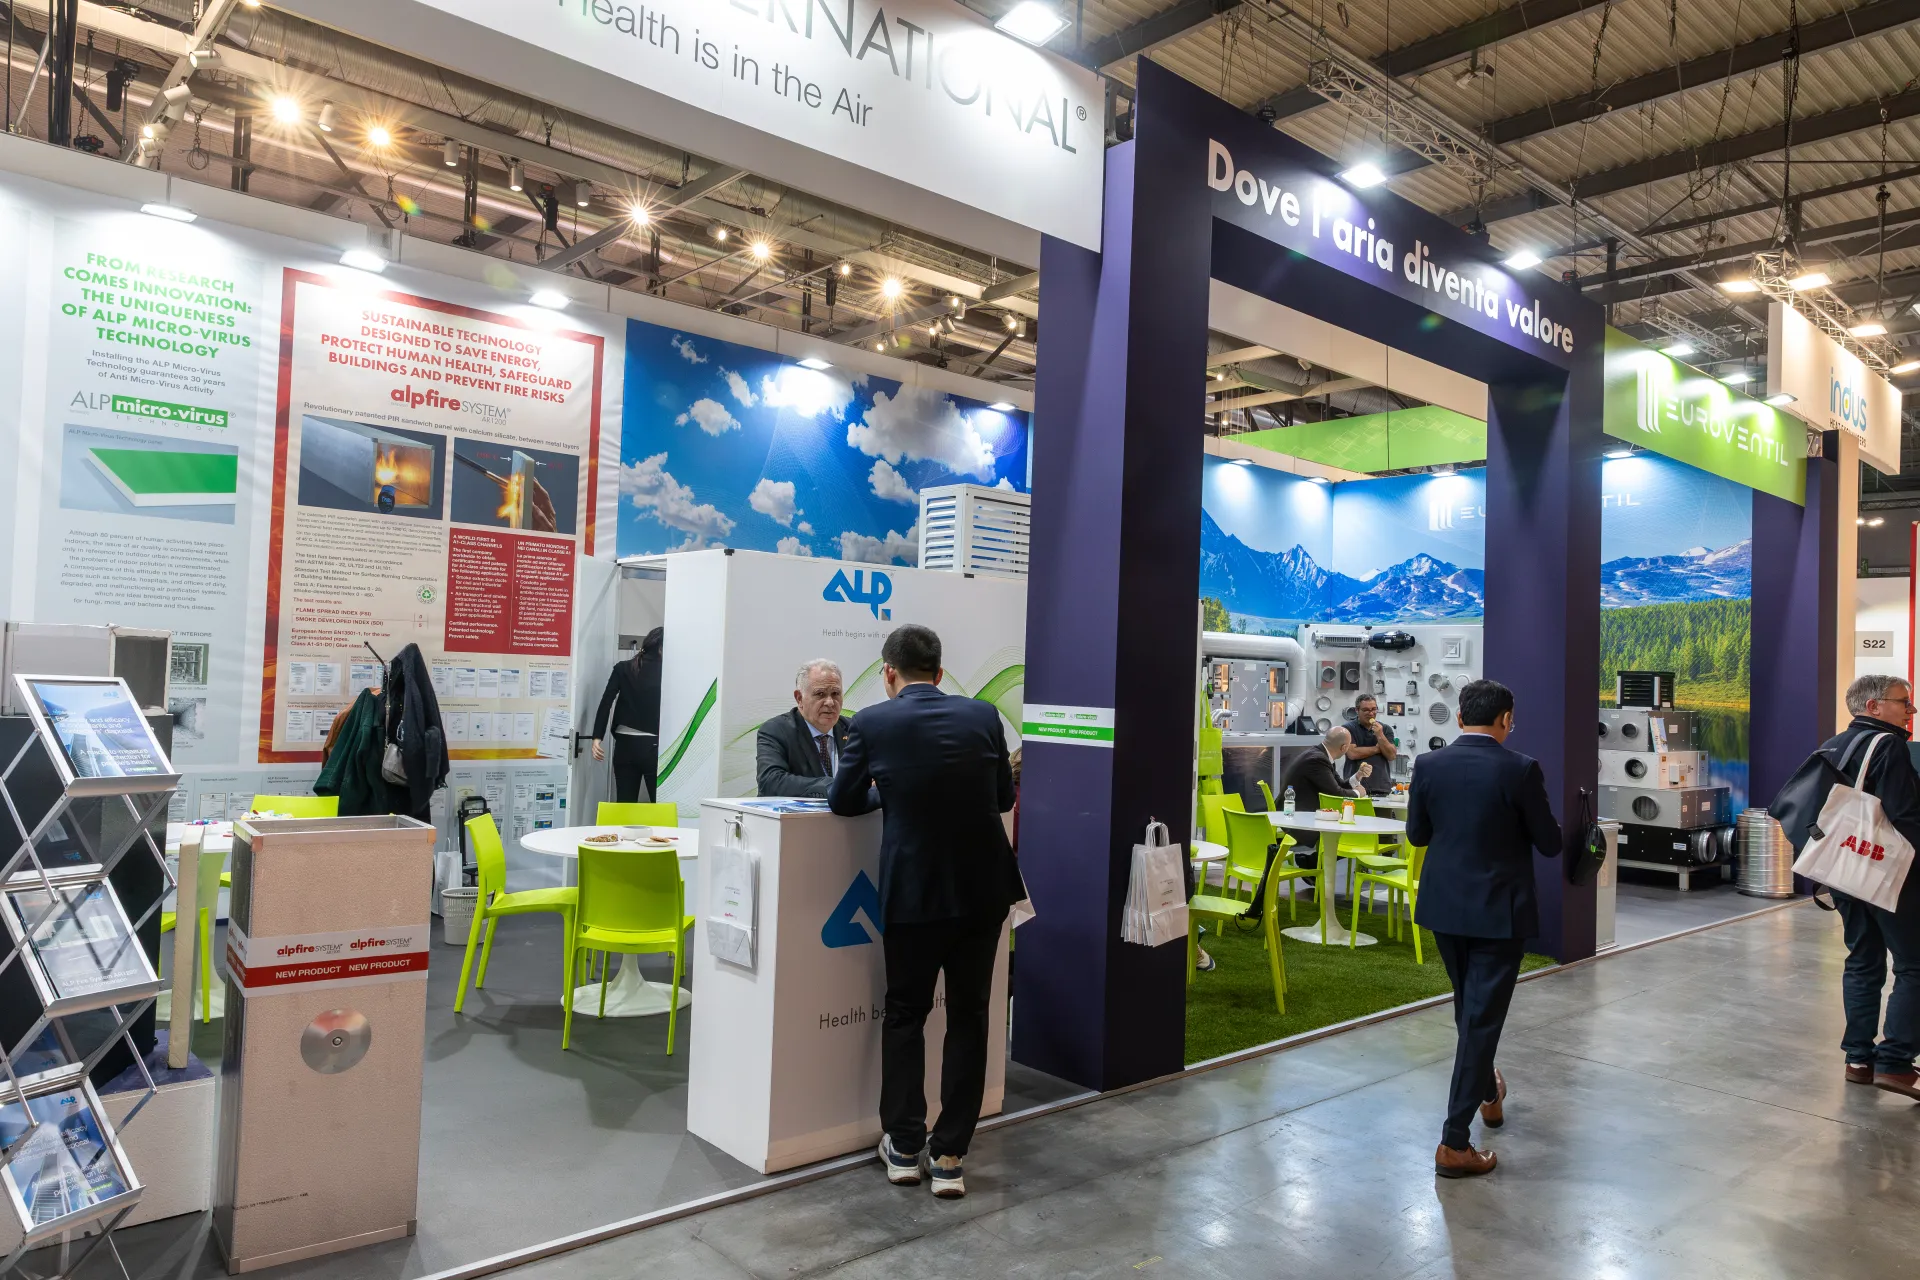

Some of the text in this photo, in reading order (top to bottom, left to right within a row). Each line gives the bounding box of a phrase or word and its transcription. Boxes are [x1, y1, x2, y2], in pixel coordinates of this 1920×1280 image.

[694, 29, 719, 69] is
[733, 44, 759, 86] in
[772, 62, 822, 108] the
[832, 87, 873, 127] Air
[1208, 138, 1300, 227] Dove
[1403, 239, 1499, 319] diventa
[1505, 300, 1574, 353] valore
[64, 266, 252, 313] COMES INNOVATION:
[87, 253, 234, 293] FROM RESEARCH
[62, 303, 250, 347] OF ALP MICRO-VIRUS
[81, 288, 235, 327] THE UNIQUENESS
[96, 327, 219, 359] TECHNOLOGY
[361, 325, 540, 371] DESIGNED TO SAVE ENERGY,
[362, 310, 542, 356] SUSTAINABLE TECHNOLOGY
[86, 358, 138, 375] Technology
[140, 368, 188, 380] guarantees
[203, 378, 226, 386] years
[92, 349, 220, 376] Installing the ALP Micro-Virus
[321, 334, 572, 390] PROTECT HUMAN HEALTH, SAFEGUARD
[329, 352, 564, 403] BUILDINGS AND PREVENT FIRE RISKS
[70, 391, 111, 410] ALP
[110, 372, 128, 381] Anti
[130, 375, 180, 389] Micro-Virus
[183, 383, 214, 396] Activity
[1830, 366, 1867, 432] indus
[304, 402, 353, 417] Revolutionary
[355, 411, 386, 420] patented
[401, 419, 432, 428] sandwich
[469, 429, 492, 437] calcium
[495, 432, 517, 442] silicate,
[519, 435, 543, 444] between
[562, 442, 579, 450] layers
[823, 568, 893, 620] ALP
[822, 629, 844, 637] Health
[845, 629, 866, 639] begins
[1862, 639, 1886, 649] S22
[1840, 835, 1885, 861] ABB
[275, 959, 411, 979] NEW PRODUCT NEW PRODUCT
[819, 1006, 866, 1029] Health
